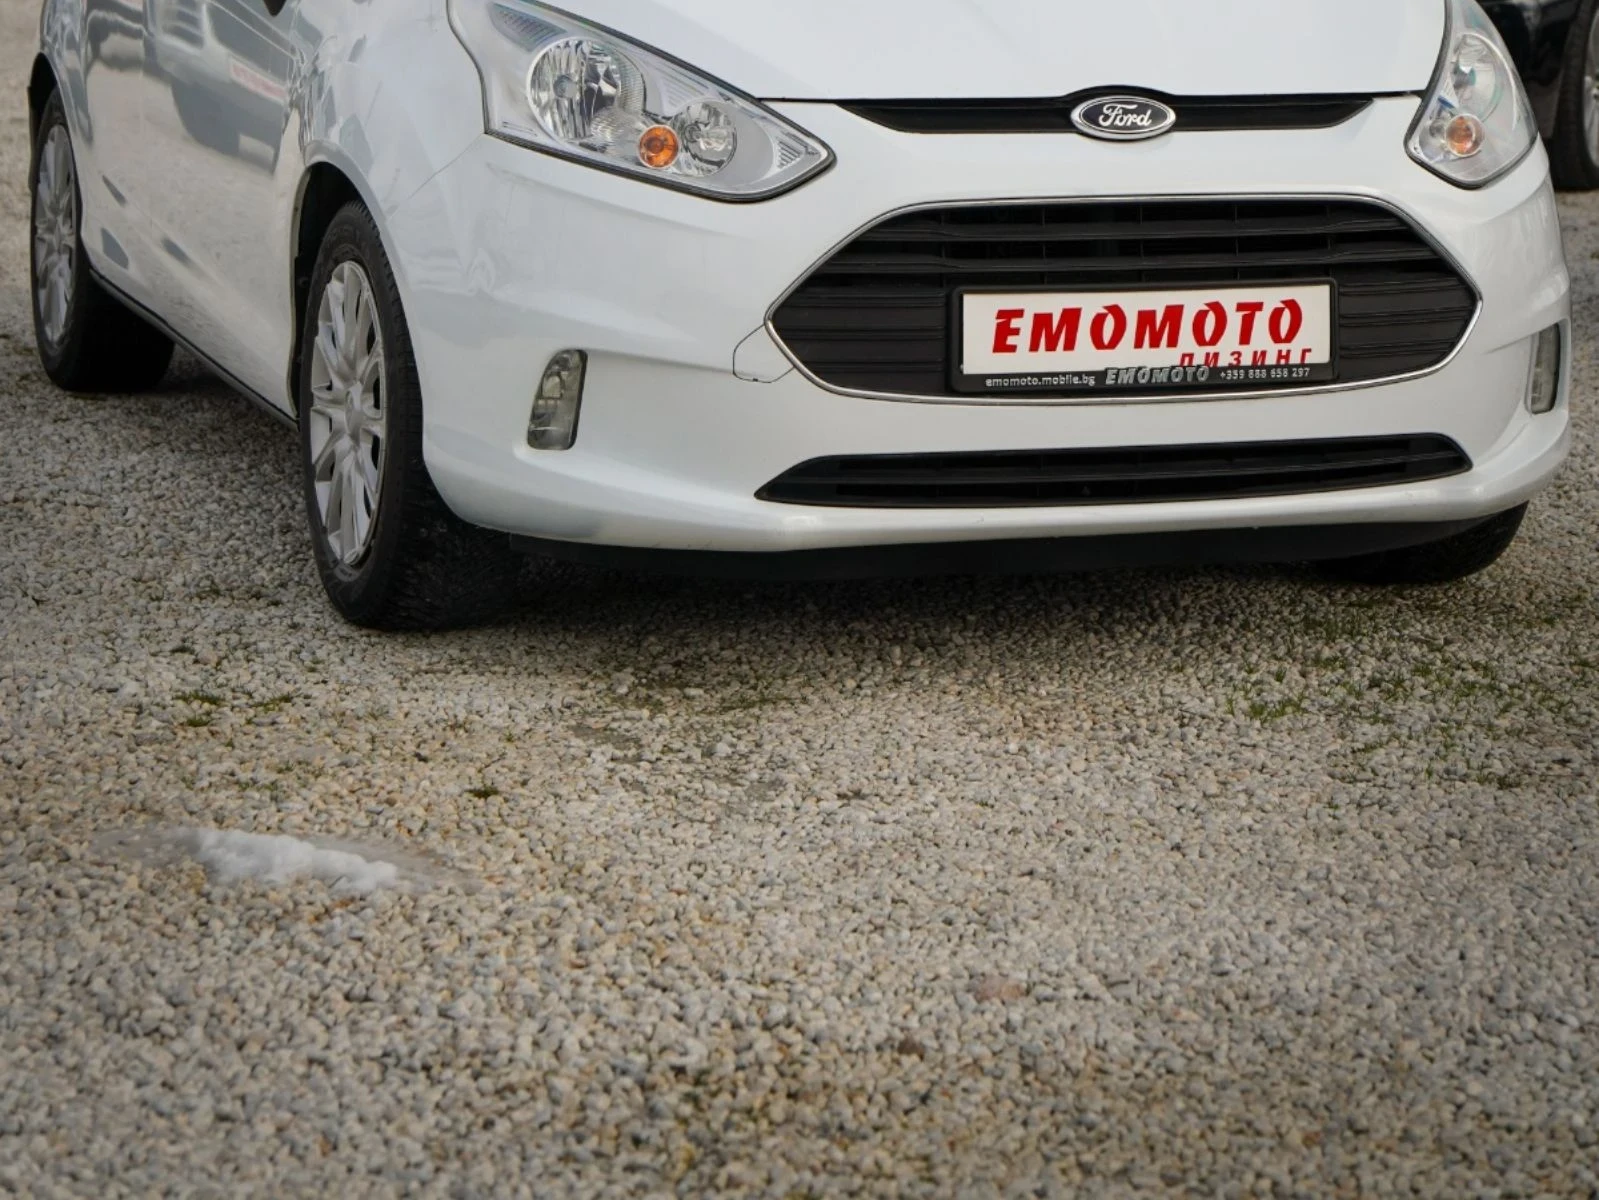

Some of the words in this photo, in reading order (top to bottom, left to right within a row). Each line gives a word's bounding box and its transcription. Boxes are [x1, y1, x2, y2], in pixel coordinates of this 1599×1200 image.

[1099, 103, 1152, 126] Ford
[992, 299, 1303, 353] EMOMOTO
[985, 374, 1096, 386] emomoto.mobile.bg
[1105, 366, 1210, 384] EMOMOTO
[1220, 369, 1245, 380] +359
[1292, 367, 1310, 377] 297
